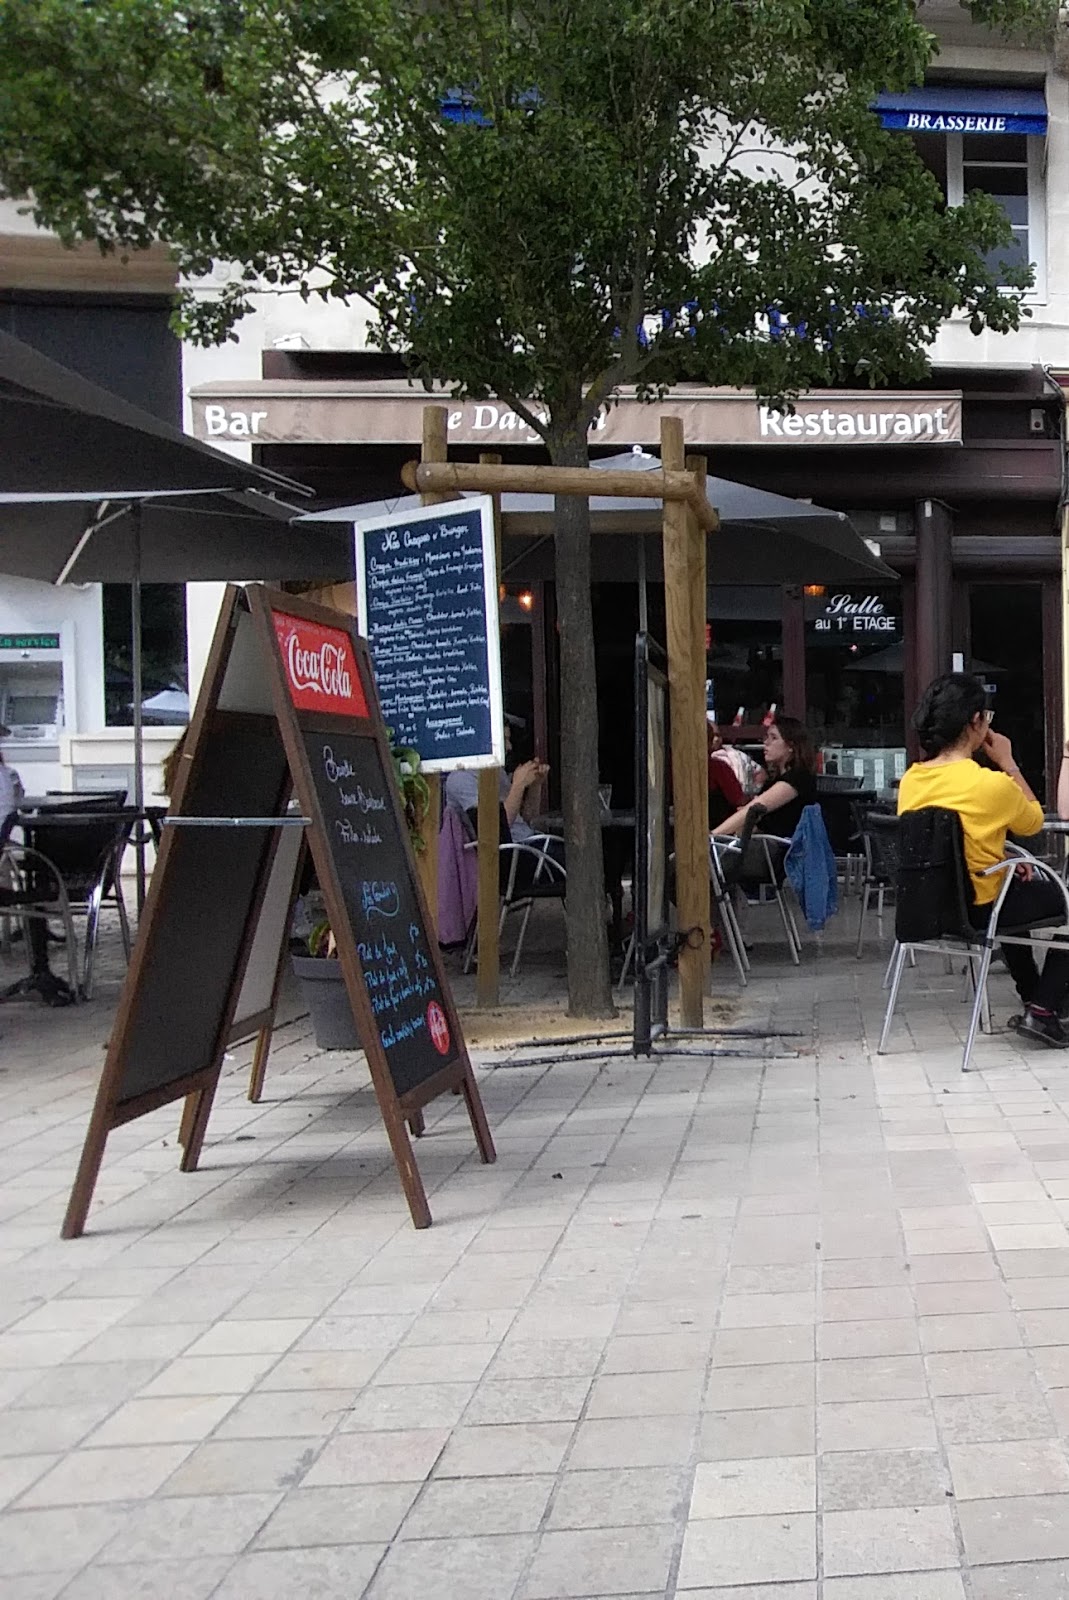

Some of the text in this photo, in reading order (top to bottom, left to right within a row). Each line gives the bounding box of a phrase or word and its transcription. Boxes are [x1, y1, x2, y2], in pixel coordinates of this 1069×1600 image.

[907, 113, 1006, 132] BRASSERIE
[205, 404, 268, 436] Bar
[447, 411, 462, 430] e
[759, 406, 950, 436] Restaurant
[826, 594, 884, 614] Salle
[815, 618, 831, 630] au
[853, 616, 896, 630] ETAGE
[288, 634, 352, 698] Coca-Cola
